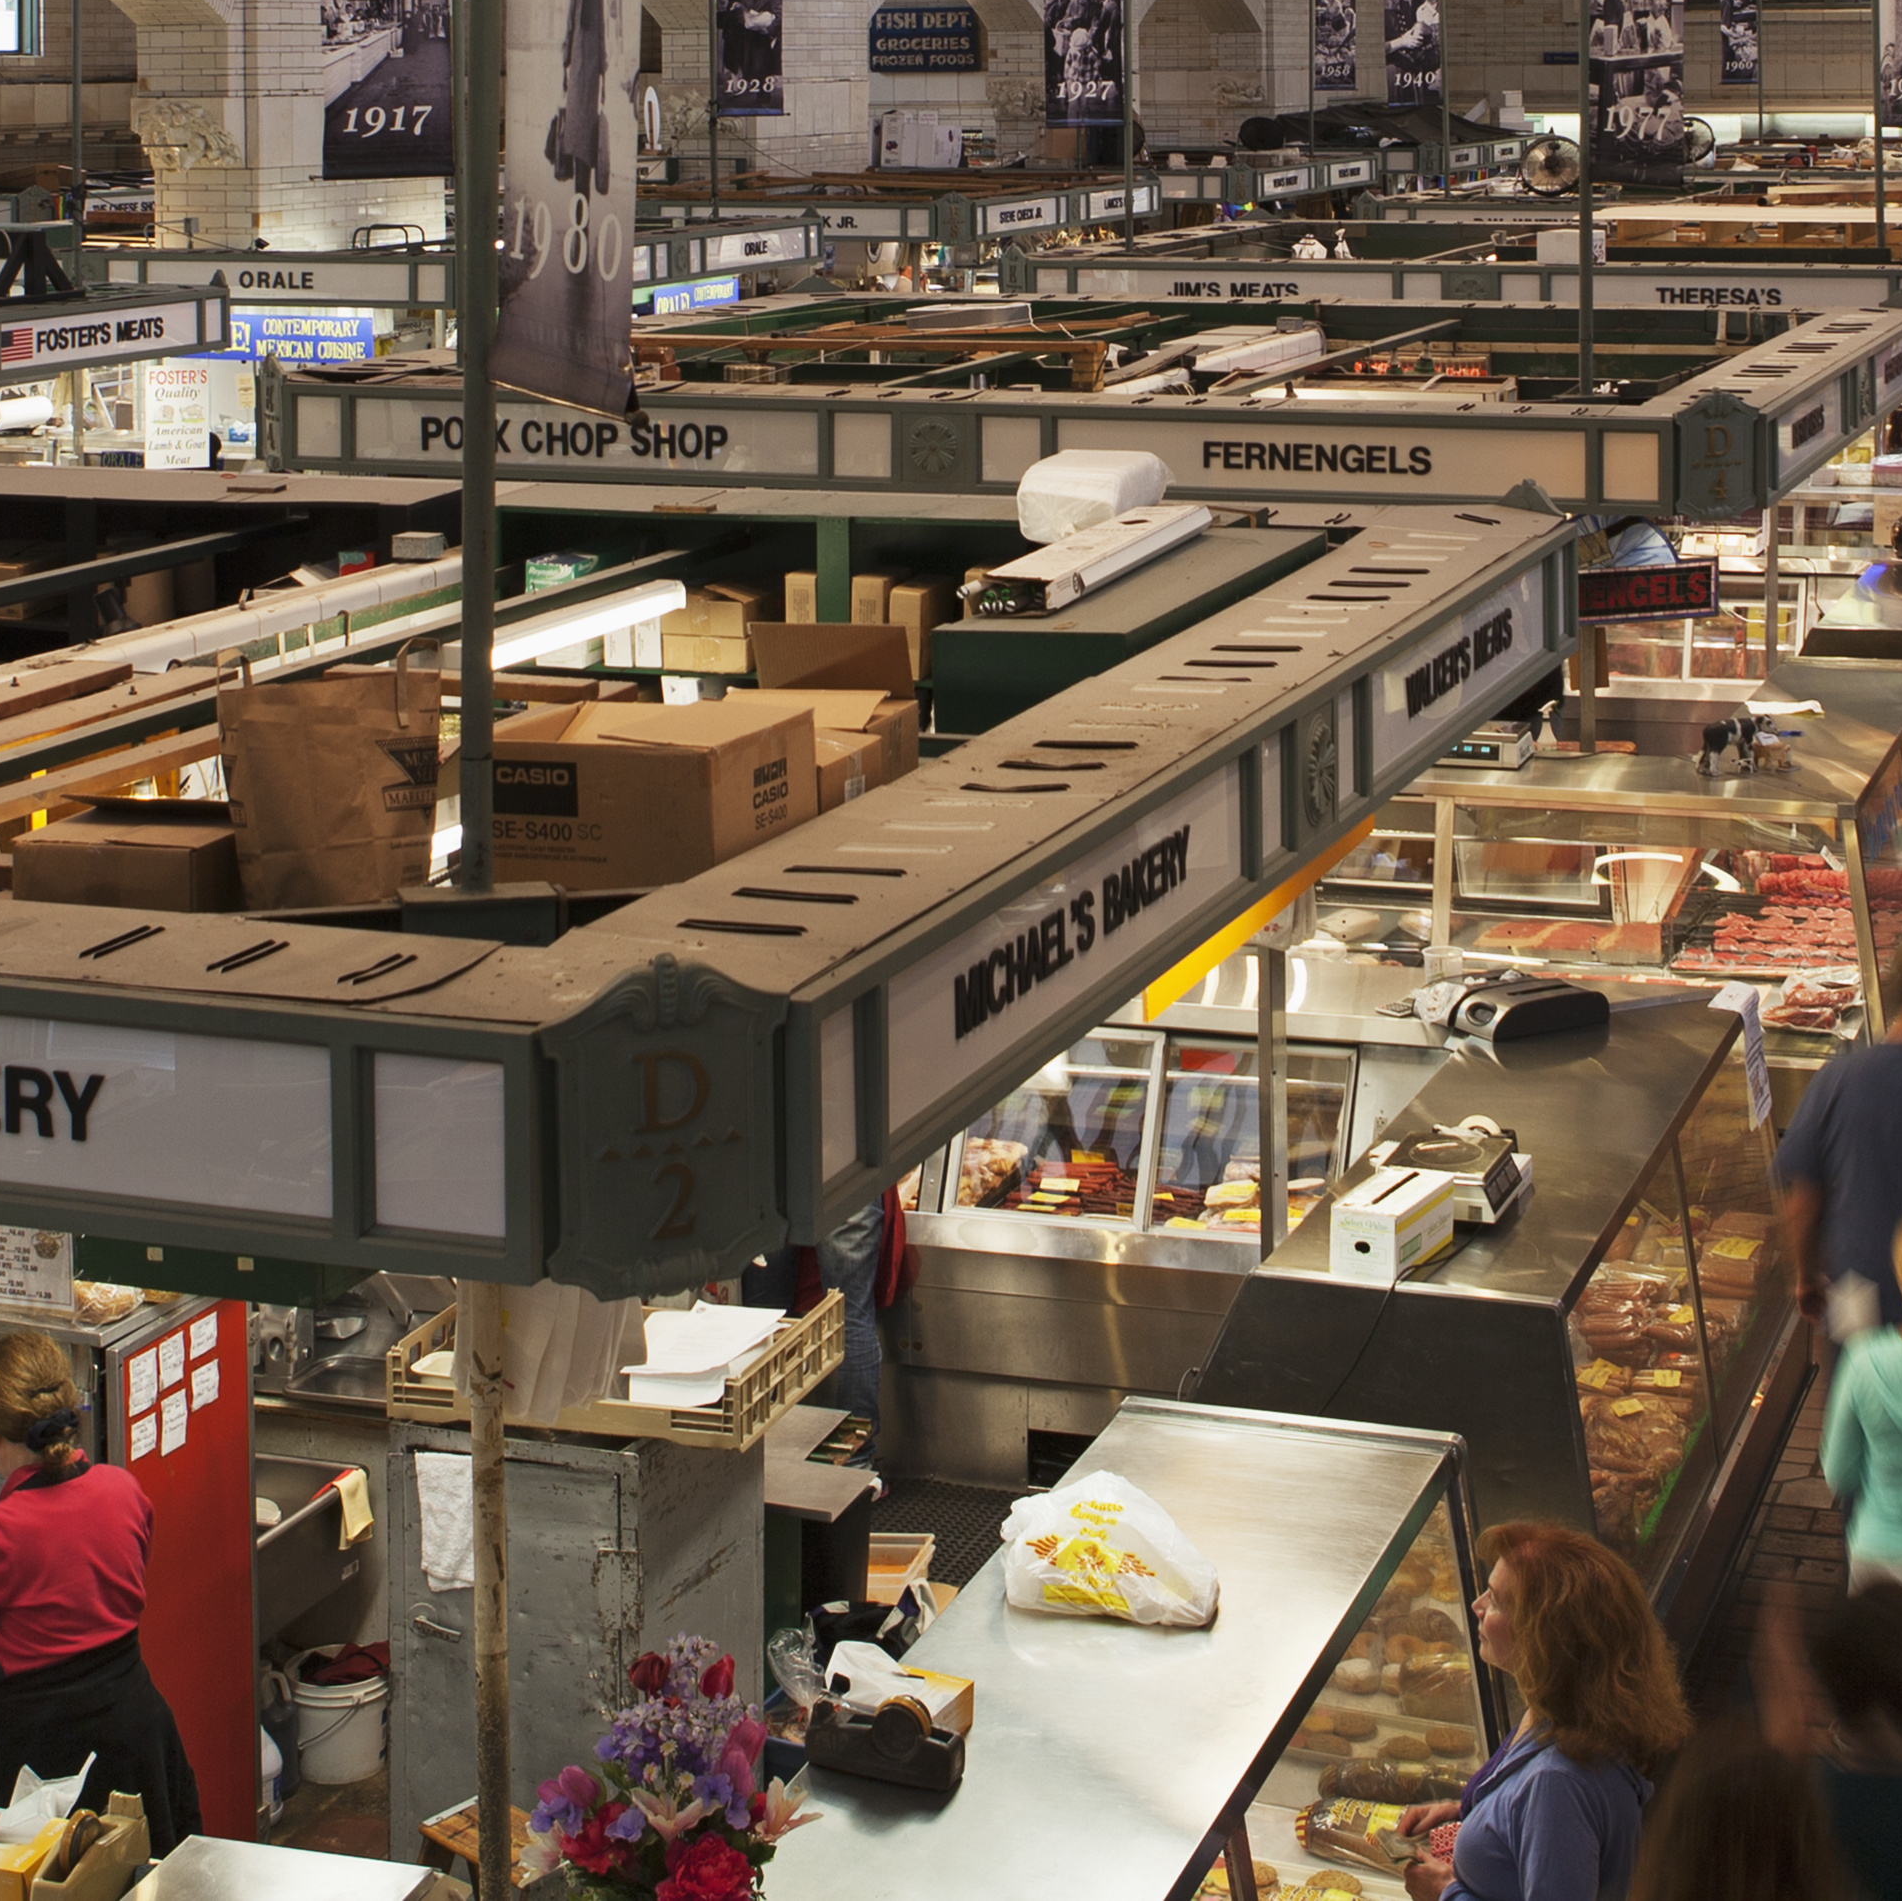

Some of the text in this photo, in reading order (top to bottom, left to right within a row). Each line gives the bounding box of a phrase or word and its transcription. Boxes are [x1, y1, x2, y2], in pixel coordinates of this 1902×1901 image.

[876, 11, 973, 29] FISH DEPT.
[875, 36, 971, 51] GROCERIES
[872, 53, 975, 67] FROZEN FOODS
[1321, 64, 1350, 78] 1958
[1394, 70, 1436, 89] 1940
[724, 77, 776, 96] 1928
[1057, 80, 1115, 101] 1927
[342, 105, 433, 138] 1917
[1603, 106, 1672, 140] 1977
[836, 216, 858, 229] JR.
[509, 192, 621, 282] 1980
[744, 240, 768, 257] ORALE
[238, 271, 314, 290] ORALE
[1167, 282, 1300, 298] JIM'S MEATS
[1655, 287, 1782, 305] THERESA'S
[37, 316, 164, 354] FOSTER'S MEATS
[261, 317, 360, 338] CONTEMPORARY
[255, 340, 366, 360] MEXICAN CUISINE
[149, 369, 208, 386] FOSTER'S
[154, 388, 201, 402] Quality
[421, 415, 729, 461] POK CHOP SHOP
[1704, 425, 1734, 459] D
[164, 454, 191, 466] Meat
[1203, 440, 1433, 477] FERNENGELS
[1707, 468, 1729, 500] 4
[1405, 606, 1514, 718] WALKER'S MEATS
[496, 766, 570, 787] CASIO
[752, 780, 789, 811] CASIO
[754, 805, 788, 832] SE-S400
[492, 820, 603, 842] SE-S400 SC
[953, 824, 1192, 1041] MICHAEL'S BAKERY
[632, 1049, 711, 1136] D
[650, 1160, 698, 1243] 2
[8, 1288, 26, 1296] GRAIN
